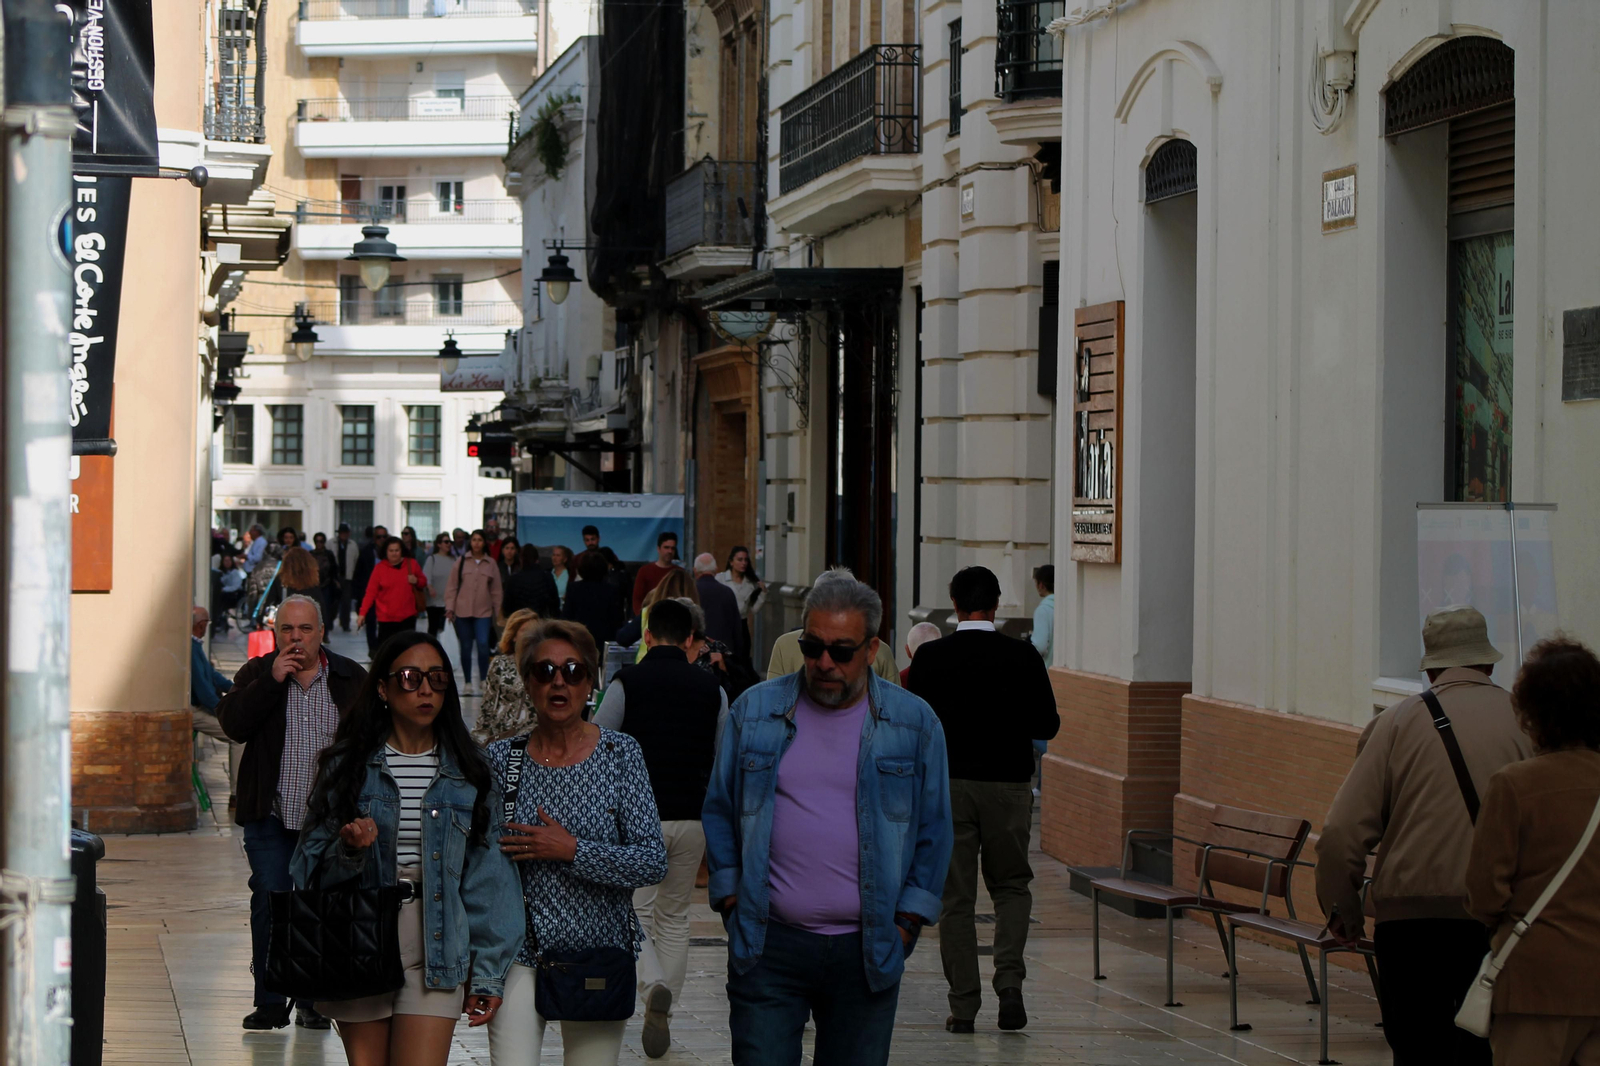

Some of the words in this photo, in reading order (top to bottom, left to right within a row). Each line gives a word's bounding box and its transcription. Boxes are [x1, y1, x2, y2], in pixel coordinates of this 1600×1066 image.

[1327, 197, 1351, 219] PALACIO
[73, 262, 104, 330] Corte
[572, 499, 642, 509] encuentro
[506, 748, 523, 793] BIMBA
